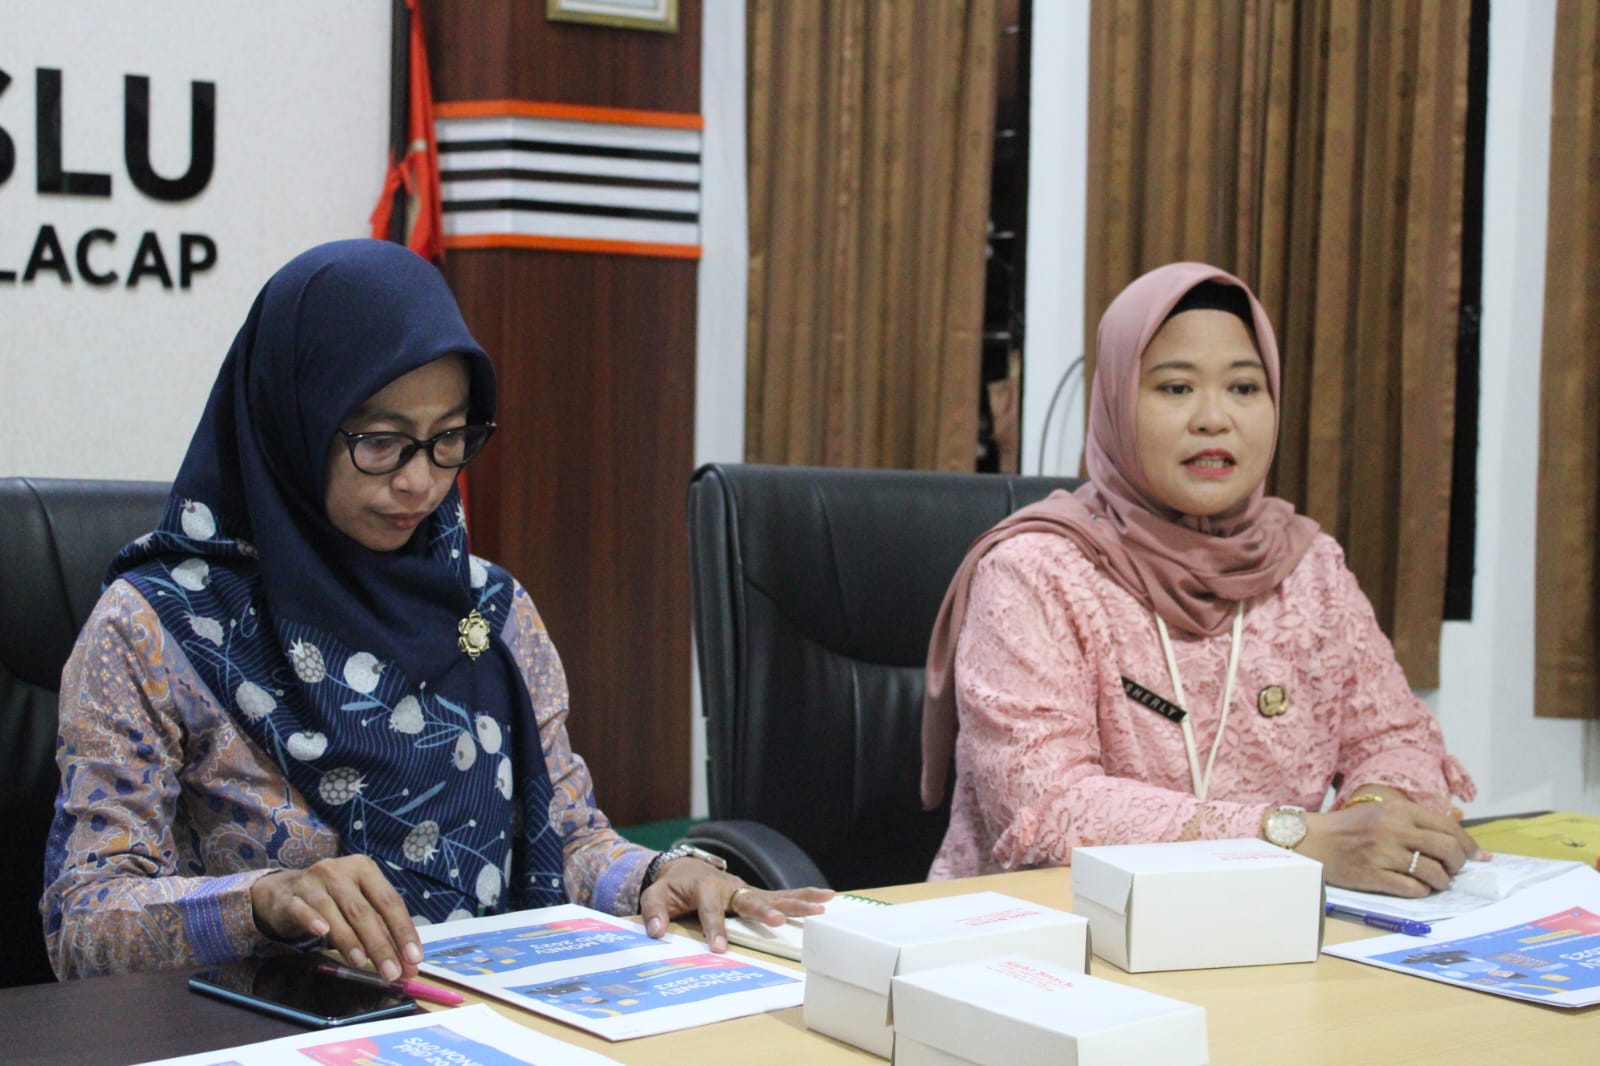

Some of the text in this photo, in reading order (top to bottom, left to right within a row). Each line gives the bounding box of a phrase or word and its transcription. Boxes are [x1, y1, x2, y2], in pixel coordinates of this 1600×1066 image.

[0, 66, 216, 202] LU
[0, 223, 218, 289] ACAP
[1125, 682, 1177, 716] SHERLY
[433, 1048, 484, 1066] MON
